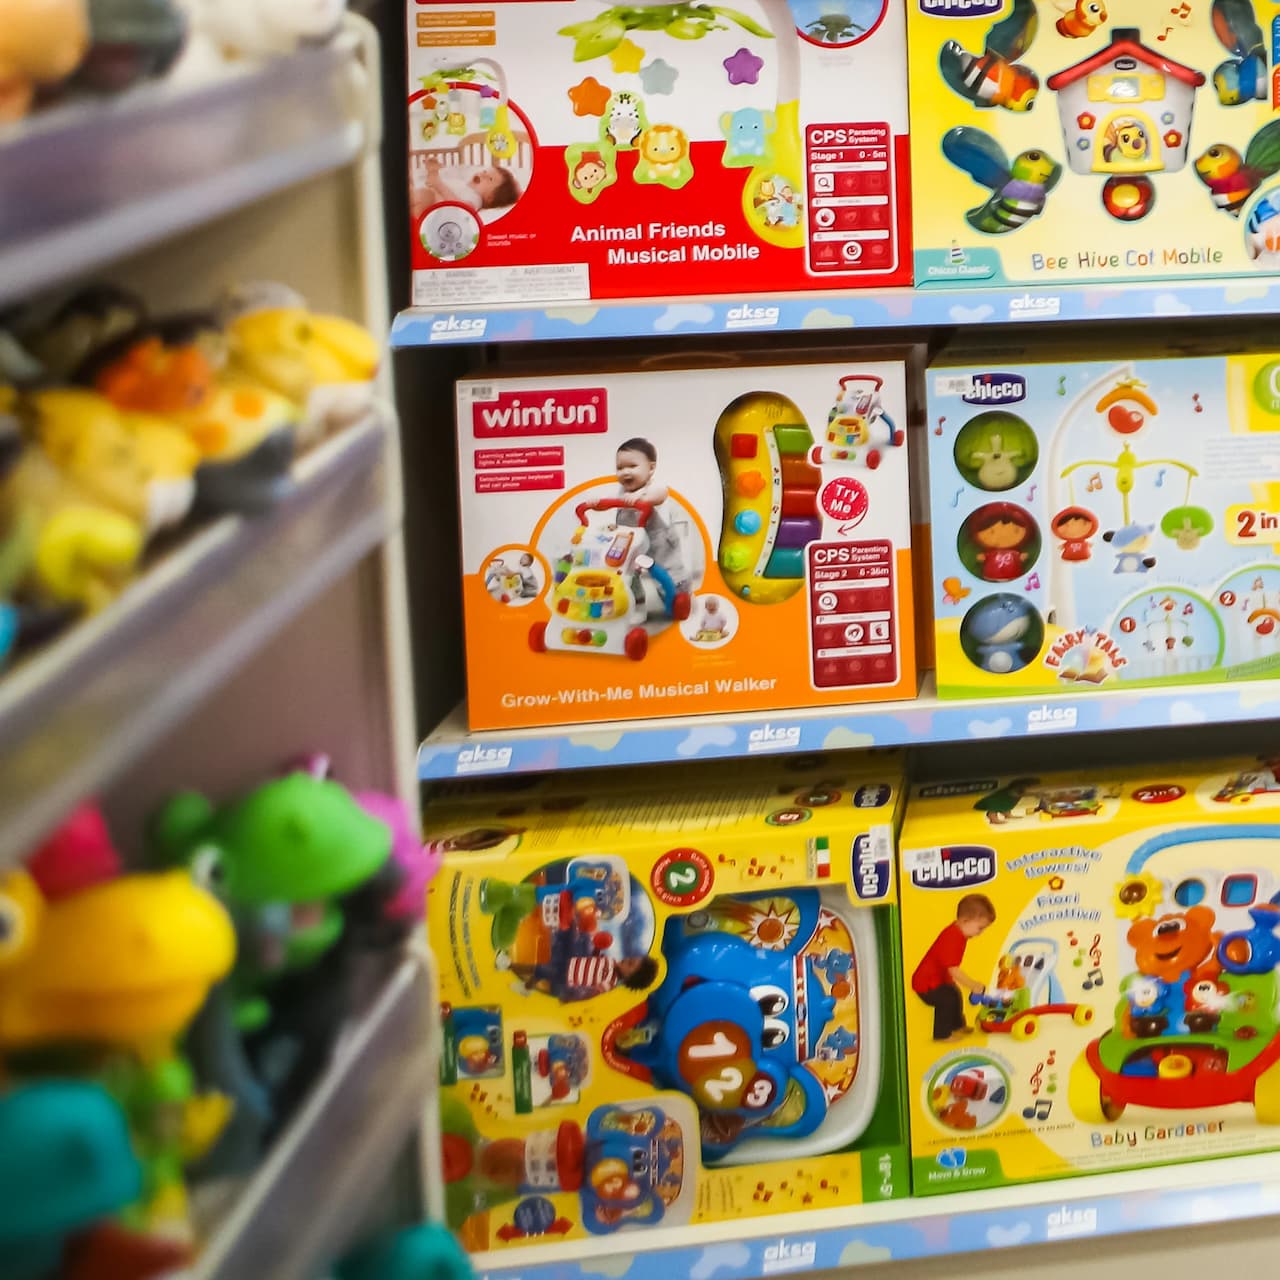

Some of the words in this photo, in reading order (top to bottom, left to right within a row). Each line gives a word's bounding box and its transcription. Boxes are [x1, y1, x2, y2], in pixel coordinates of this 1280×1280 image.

[810, 128, 847, 145] CPS
[571, 225, 643, 243] Animal
[648, 221, 726, 241] Friends
[608, 245, 686, 266] Musical
[693, 243, 760, 262] Mobile
[1032, 252, 1068, 270] Bee
[1077, 250, 1119, 268] Hive
[1126, 248, 1154, 266] Cot
[1163, 247, 1223, 266] Mobile
[728, 304, 779, 319] aksa
[966, 375, 1022, 401] chicco
[482, 399, 597, 429] winfun
[835, 486, 859, 503] Try
[830, 498, 852, 514] Me
[1237, 510, 1256, 538] 2
[1260, 513, 1277, 530] in
[814, 548, 850, 563] CPS
[502, 686, 633, 709] Grow-With-Me
[639, 681, 709, 699] Musical
[715, 677, 777, 693] Walker
[750, 725, 800, 742] aksa
[914, 850, 991, 885] chicco
[1091, 1128, 1137, 1148] Baby
[1144, 1120, 1225, 1141] Gardener
[764, 1240, 816, 1258] aksa
